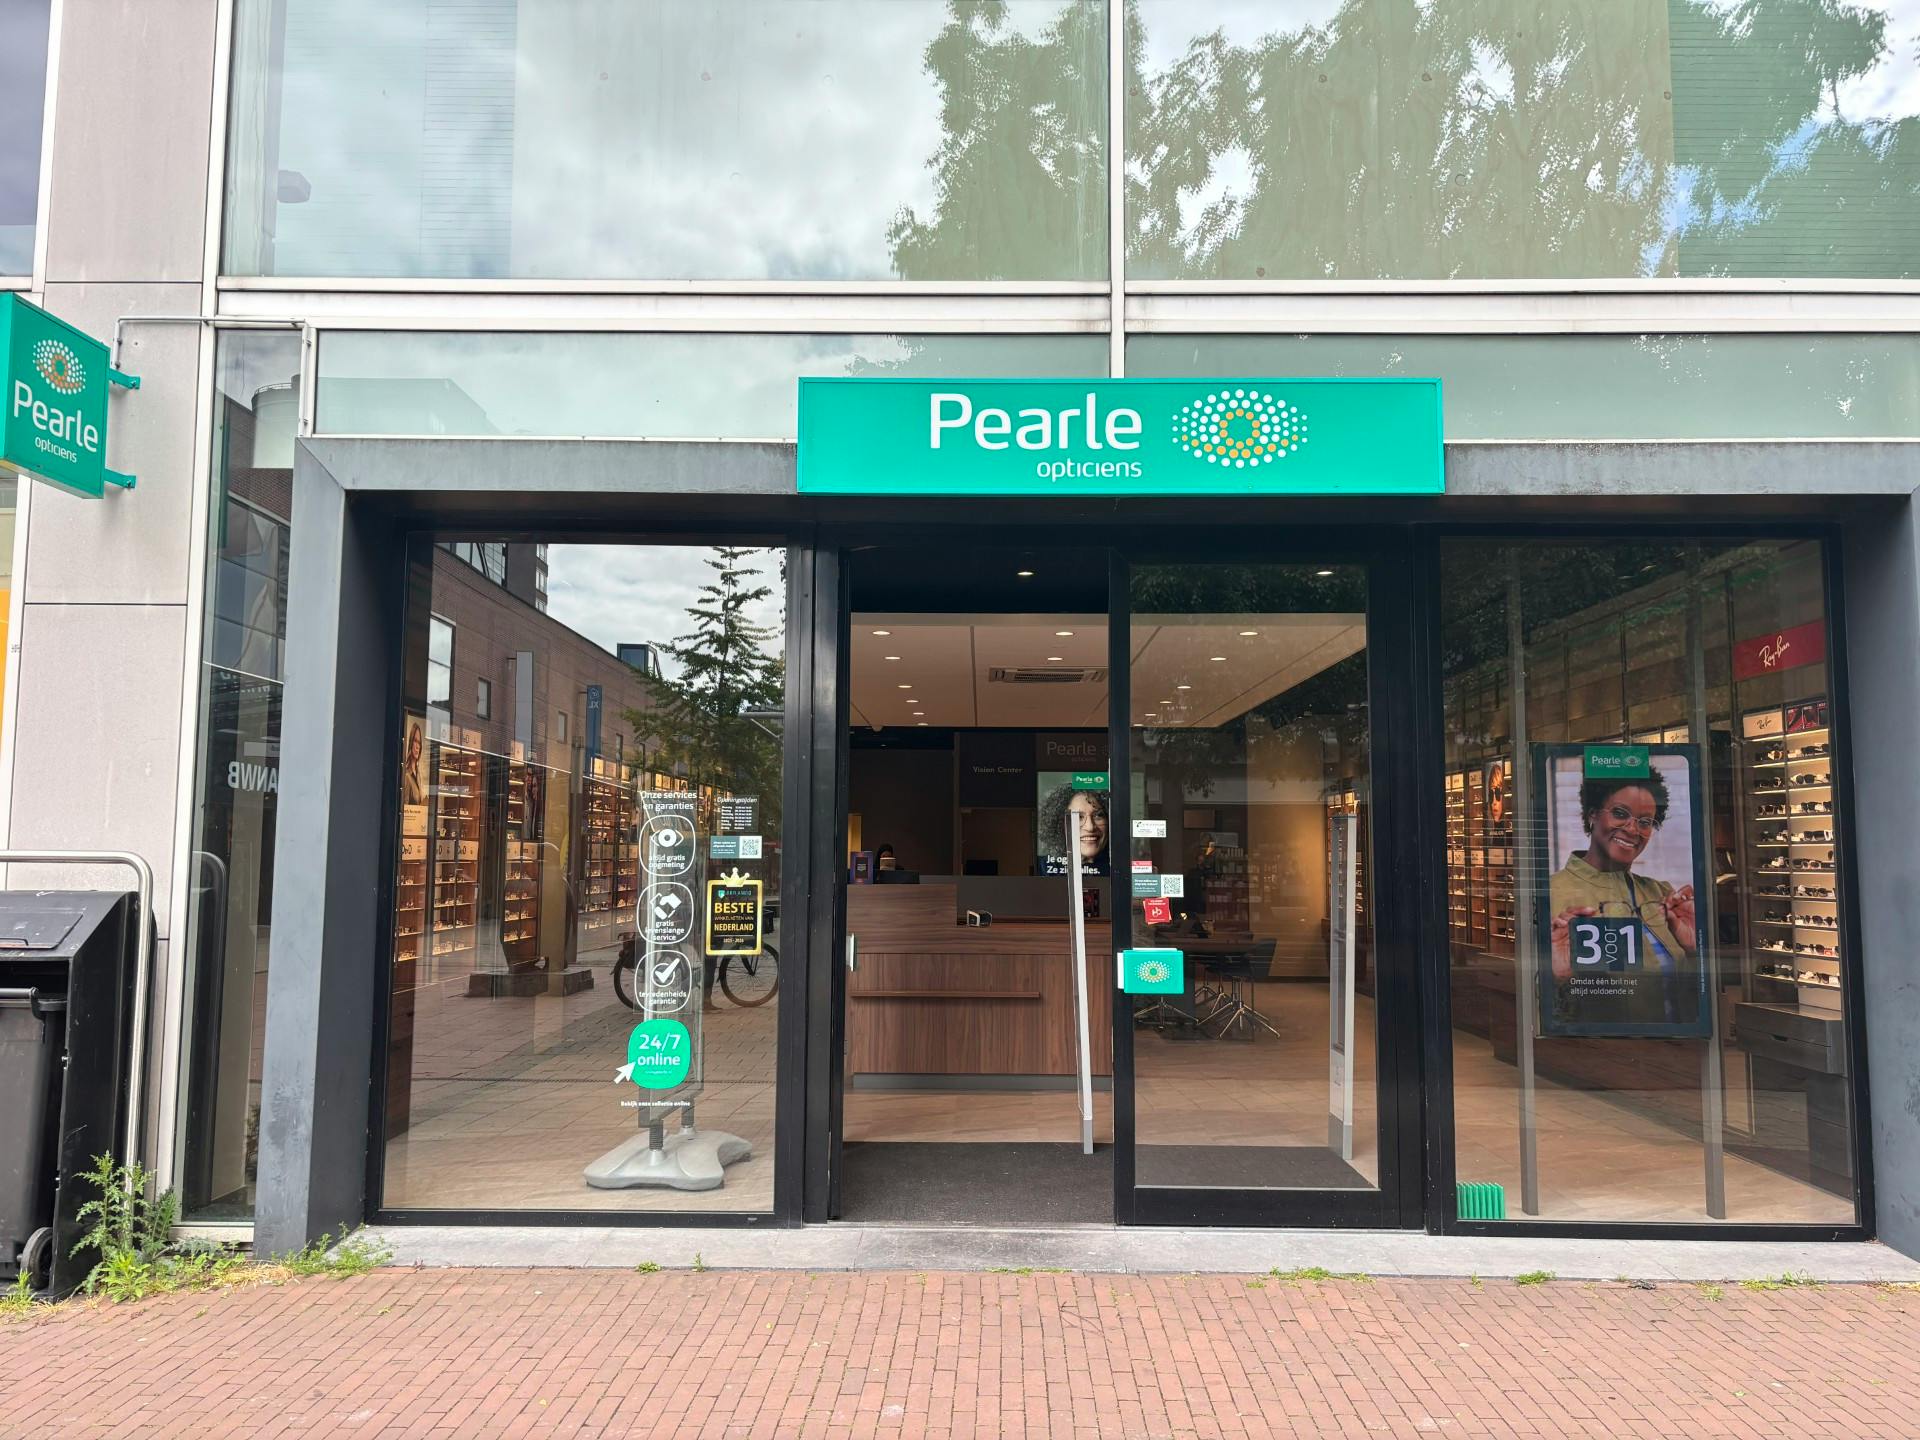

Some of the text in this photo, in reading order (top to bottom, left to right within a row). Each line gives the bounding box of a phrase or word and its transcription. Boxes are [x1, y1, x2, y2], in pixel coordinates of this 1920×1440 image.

[14, 379, 98, 452] Pearle
[930, 392, 1142, 451] Pearle
[35, 436, 77, 463] opticiens
[1036, 457, 1142, 482] opticiens
[1759, 635, 1790, 668] Ray-Ban
[1046, 741, 1097, 756] Pearle
[1592, 755, 1621, 766] Pearle
[640, 790, 698, 799] Onze services
[655, 801, 694, 812] garanties
[1046, 855, 1056, 864] Je
[1046, 866, 1058, 874] Ze
[714, 902, 754, 914] BESTE
[655, 919, 675, 928] gratis
[714, 923, 754, 931] NEDERLAND
[652, 933, 677, 941] service
[1576, 924, 1636, 965] 3 voor 1
[1570, 977, 1595, 986] Omdat
[1610, 977, 1623, 986] bril
[1623, 977, 1638, 986] niet
[1570, 987, 1589, 997] altijd
[1589, 987, 1627, 995] voldoende
[638, 1032, 681, 1052] 24/7
[637, 1052, 681, 1066] online
